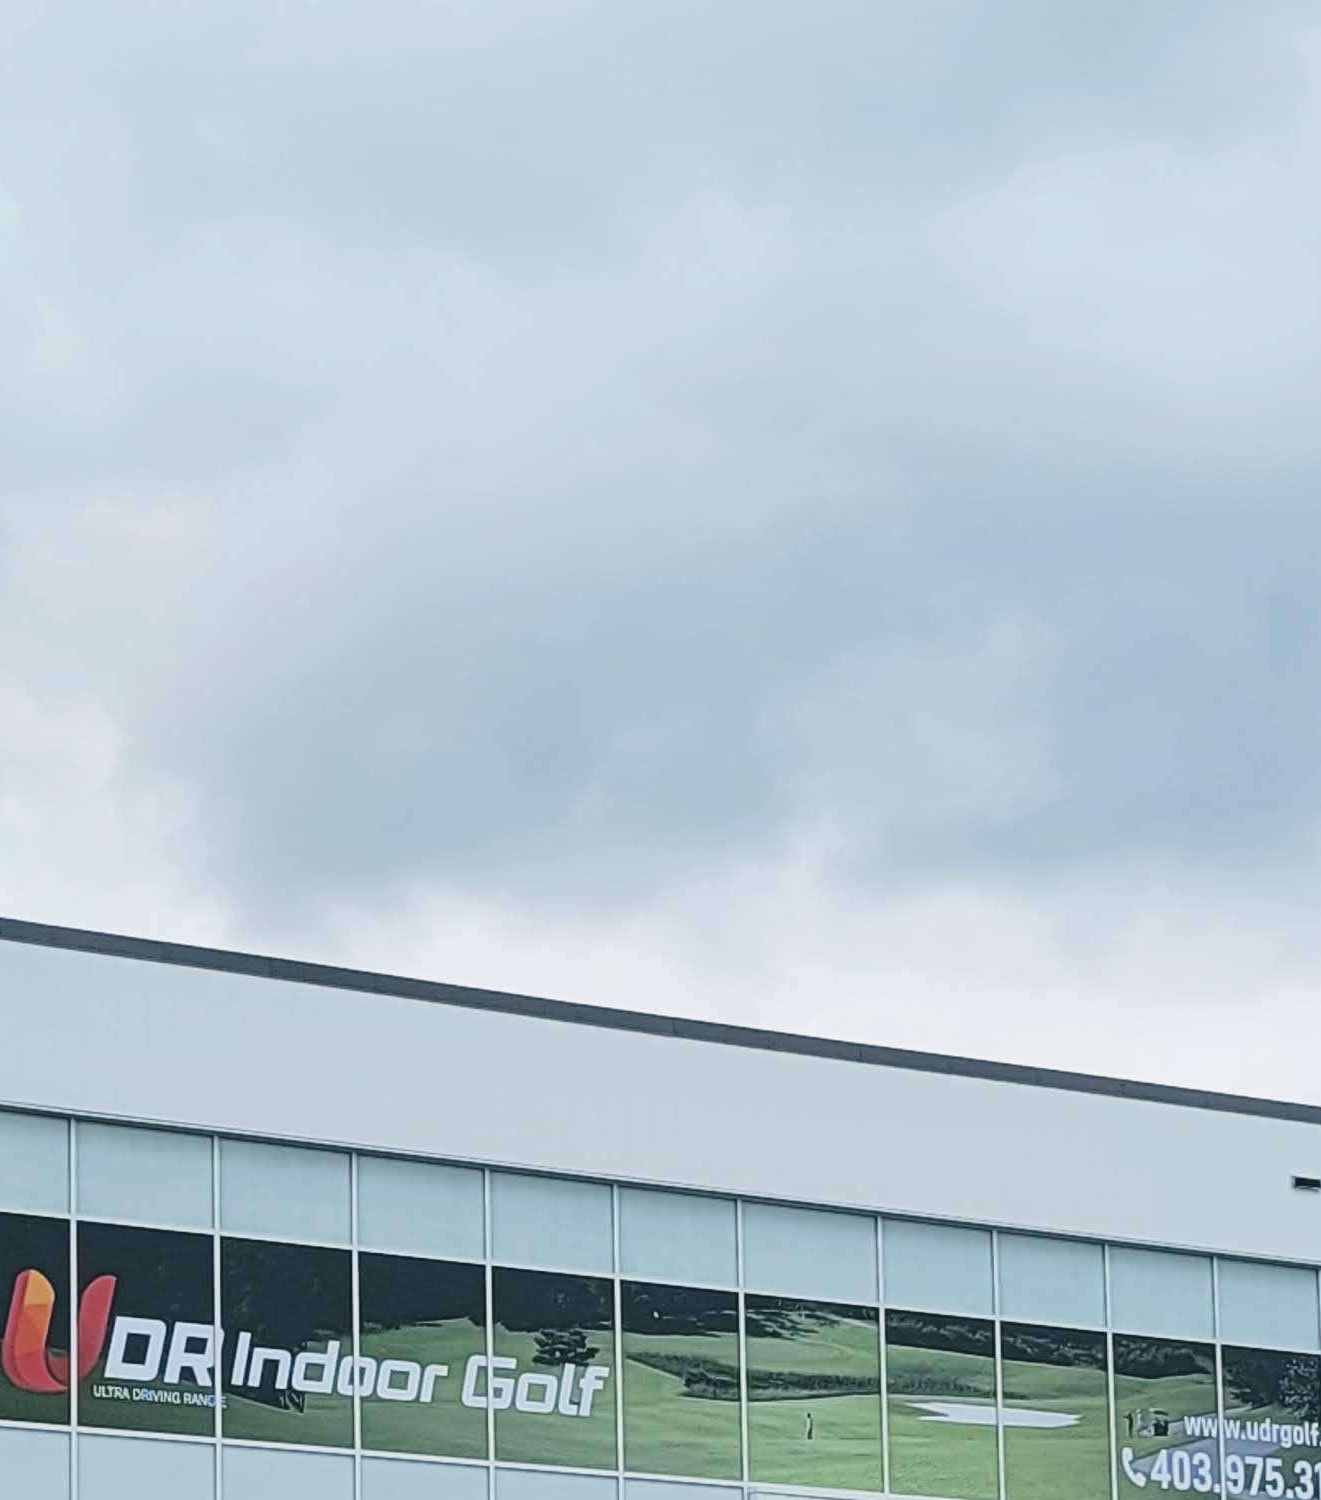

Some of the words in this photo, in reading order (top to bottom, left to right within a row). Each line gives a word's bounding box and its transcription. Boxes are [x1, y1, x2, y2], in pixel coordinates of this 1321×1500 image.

[93, 1384, 131, 1400] ULTRA
[132, 1388, 181, 1404] DRIVING
[231, 1330, 448, 1404] Indoor
[462, 1353, 611, 1417] Golf
